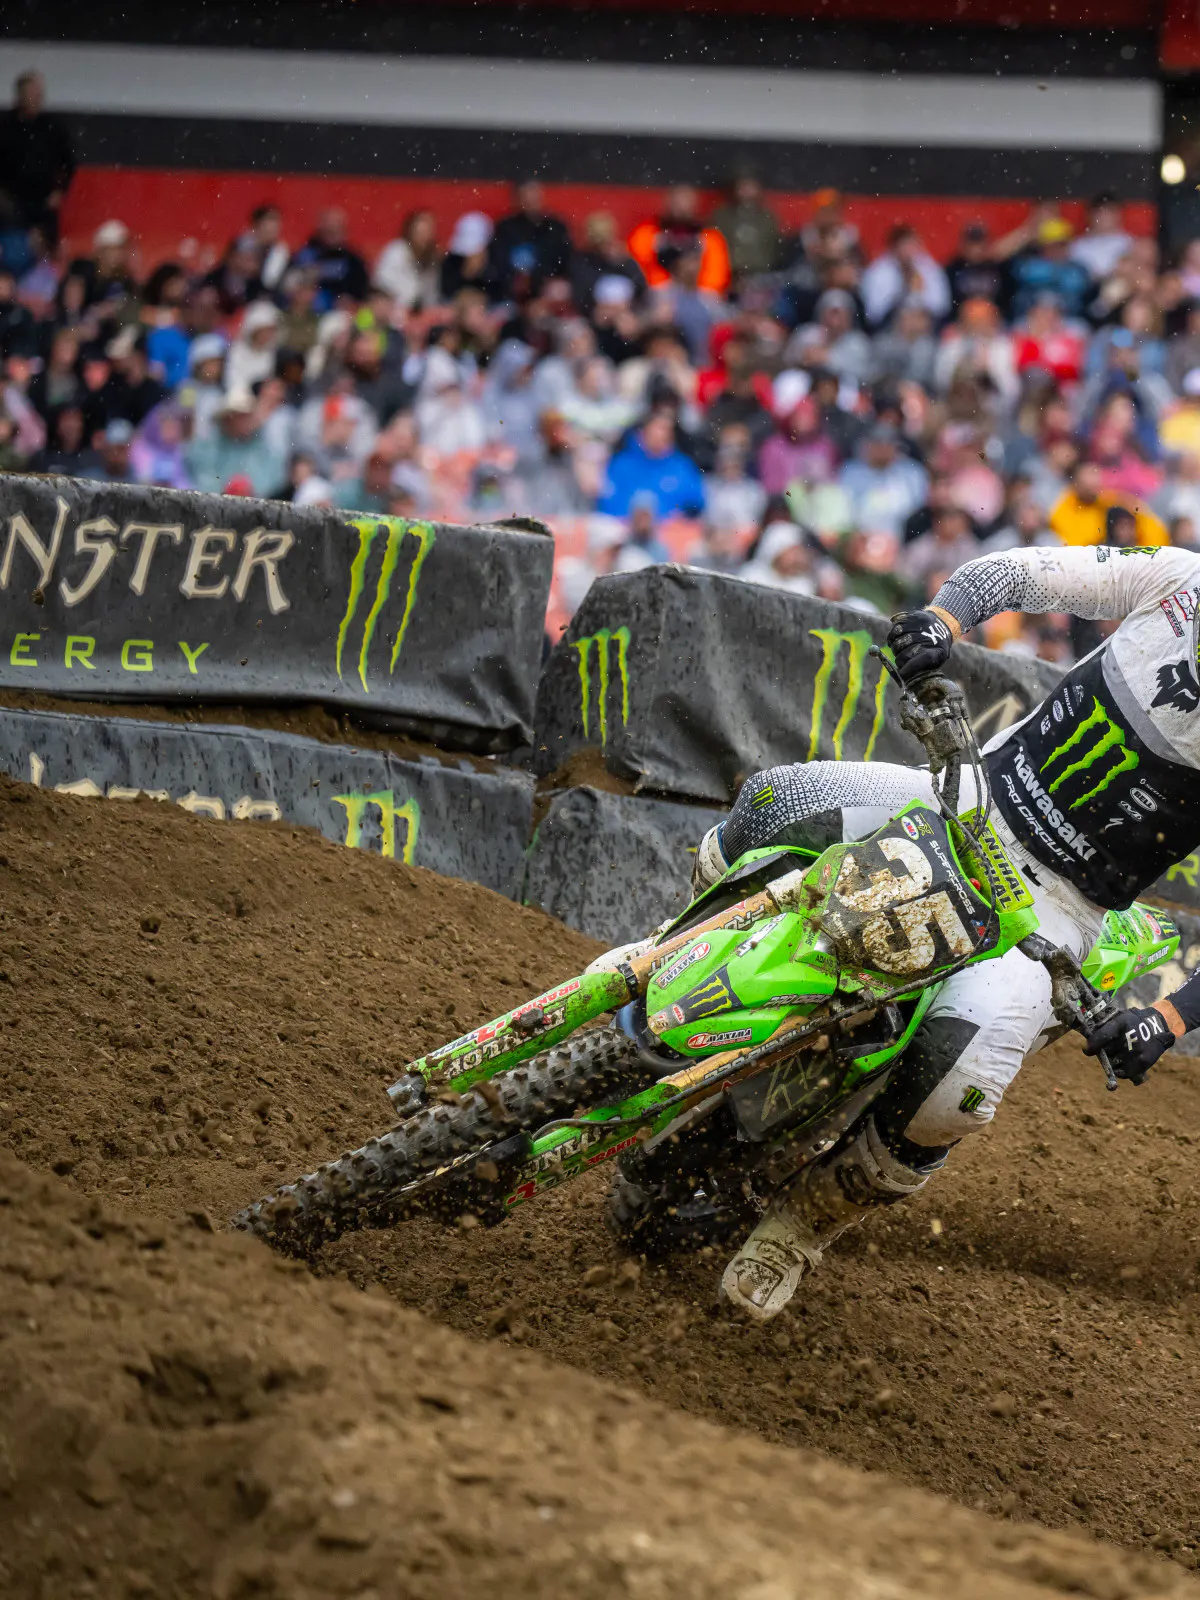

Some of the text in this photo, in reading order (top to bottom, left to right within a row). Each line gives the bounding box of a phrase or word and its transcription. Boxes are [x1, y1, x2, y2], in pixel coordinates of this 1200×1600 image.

[10, 633, 210, 675] ERGY
[1063, 687, 1075, 717] DUNLOP
[1133, 790, 1156, 811] BELL
[903, 821, 918, 838] AMA
[1001, 774, 1076, 863] PRO CIRCUIT
[928, 839, 976, 915] SUPERCROSS
[658, 952, 698, 987] MAXIMA
[1146, 945, 1171, 965] DUNLOP
[673, 1006, 685, 1023] BELL
[706, 1028, 752, 1043] MAXIMA
[1125, 1015, 1164, 1051] FOX
